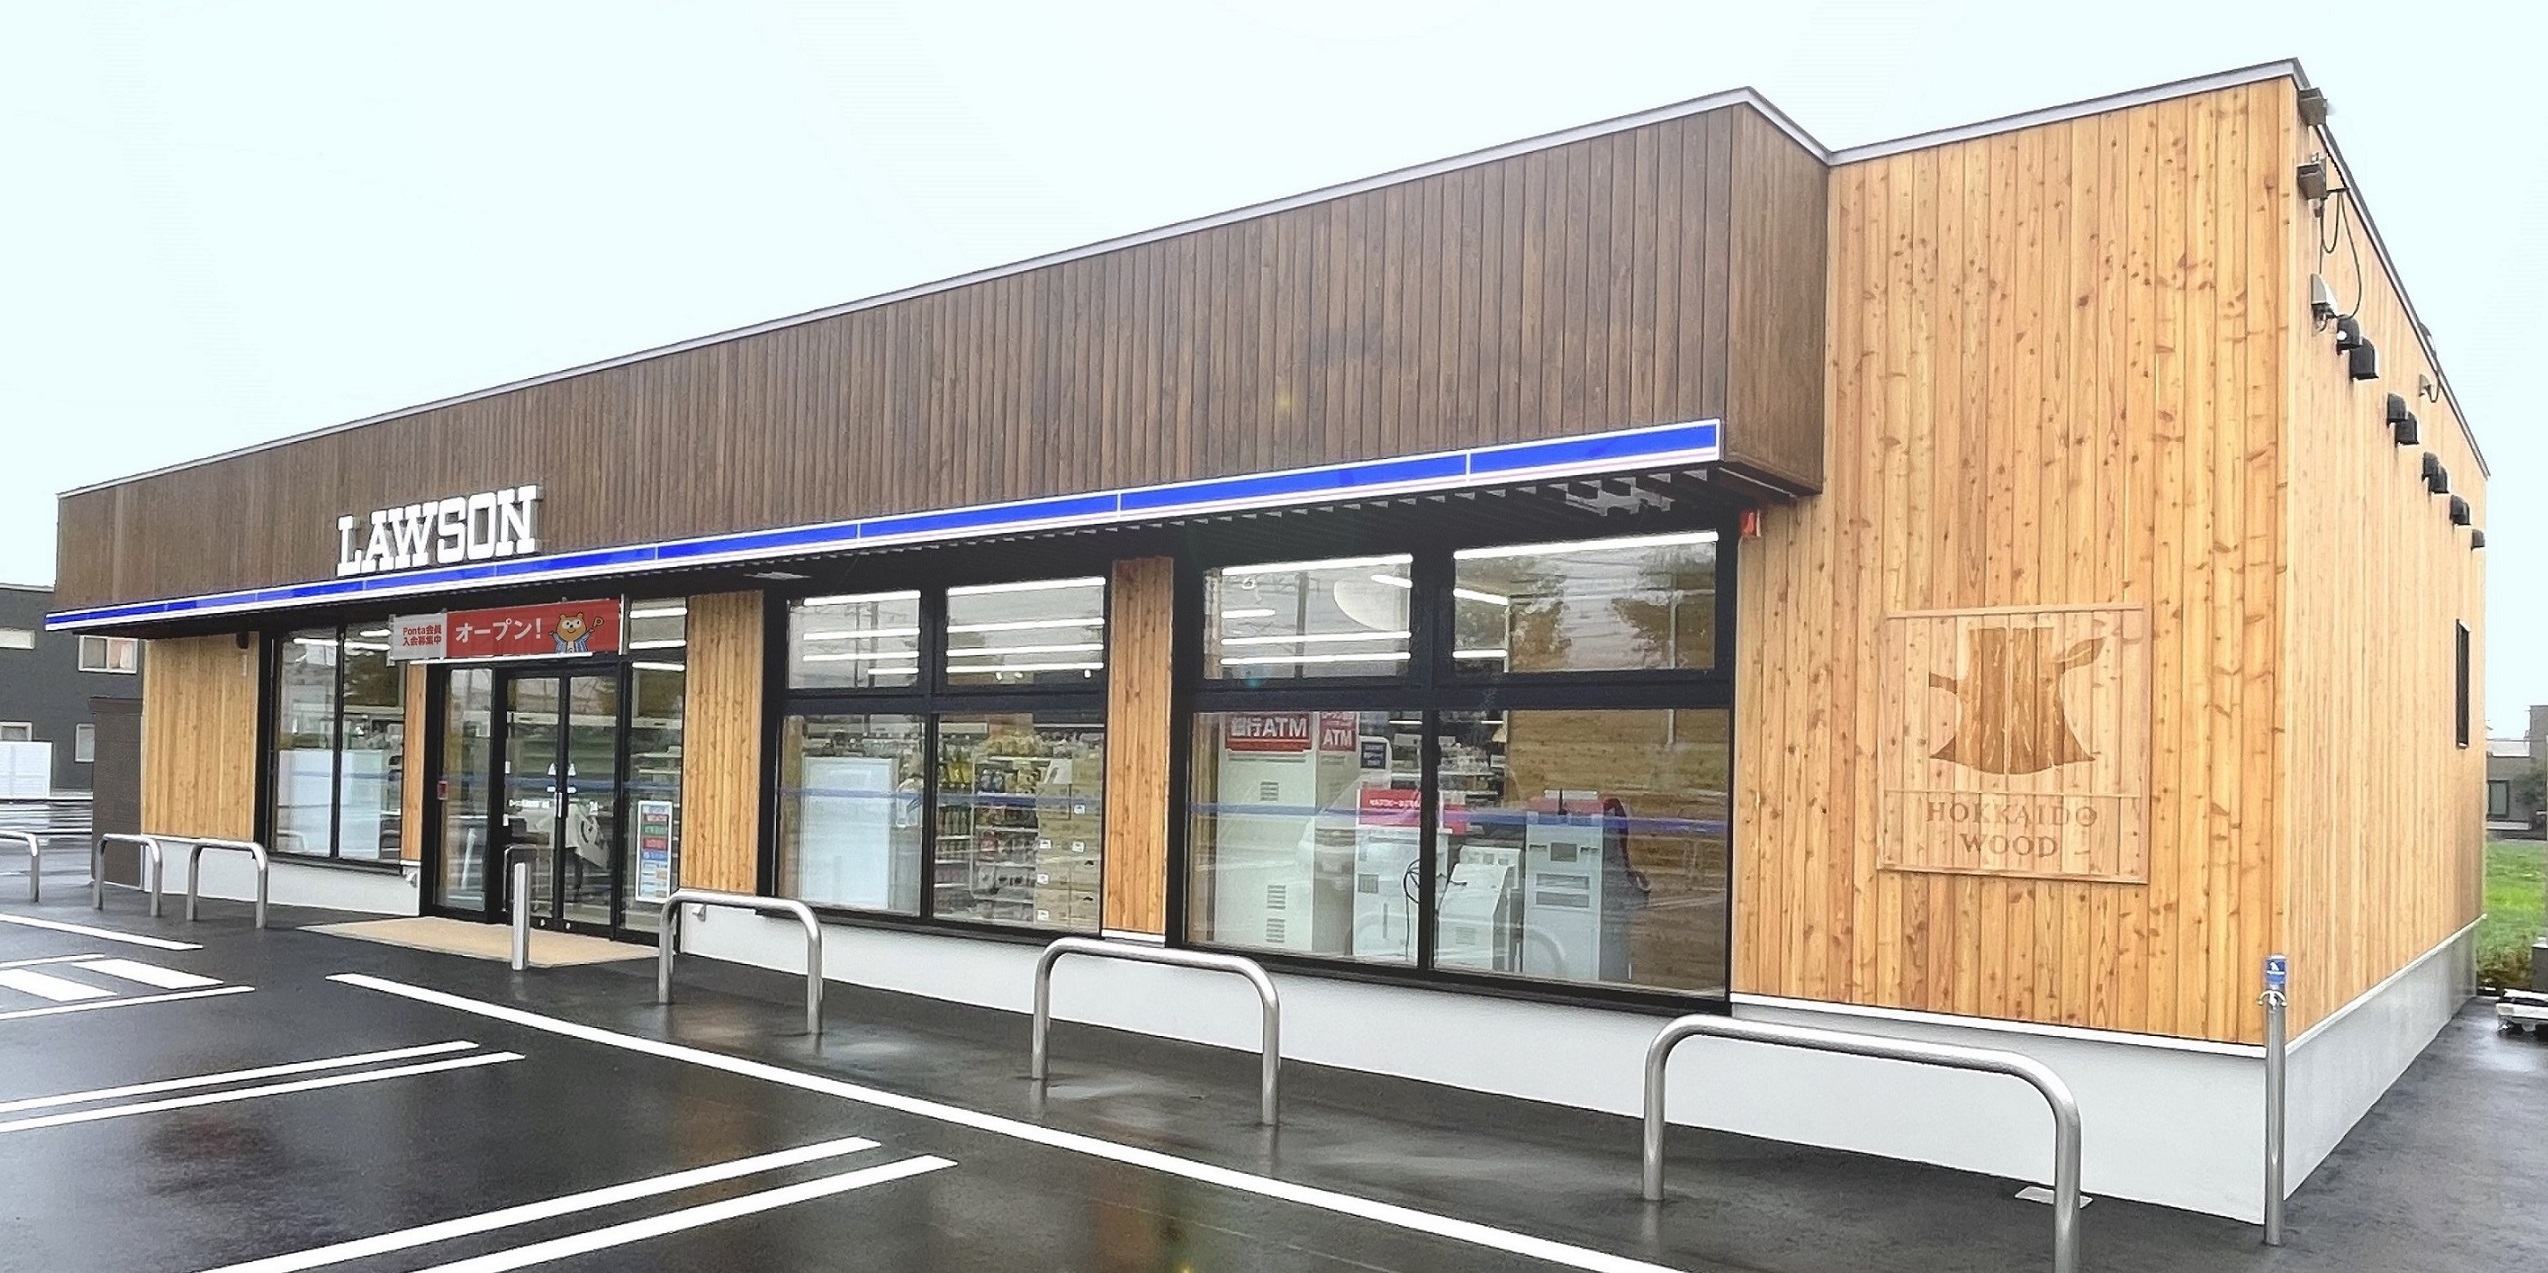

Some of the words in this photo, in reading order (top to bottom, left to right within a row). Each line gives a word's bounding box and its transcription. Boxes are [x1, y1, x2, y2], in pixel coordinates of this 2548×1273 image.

[337, 484, 540, 577] LAWSON
[403, 624, 442, 636] Ponta会員
[403, 635, 442, 647] 入会募集中
[455, 617, 542, 643] オープン!
[1322, 728, 1352, 747] ATM
[1926, 801, 2098, 828] HOKKAIDO
[1960, 833, 2059, 858] WOOD
